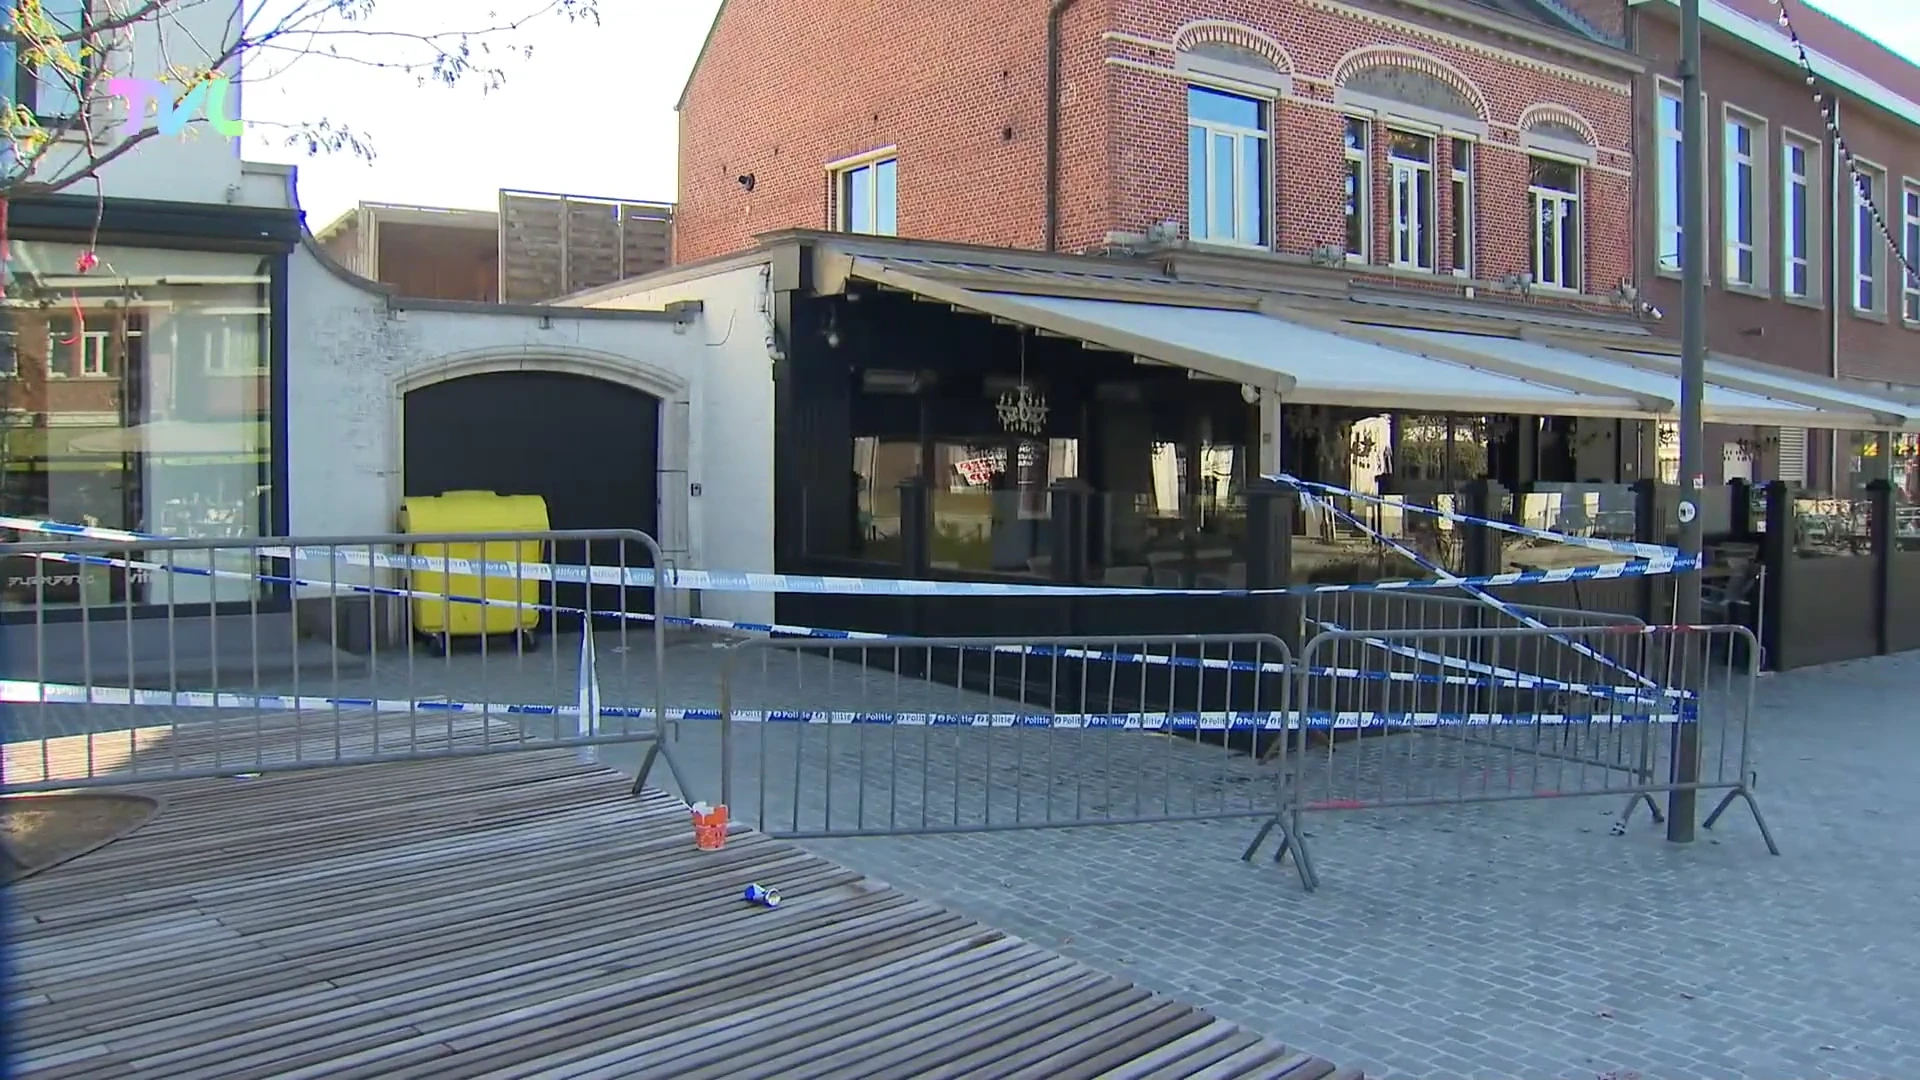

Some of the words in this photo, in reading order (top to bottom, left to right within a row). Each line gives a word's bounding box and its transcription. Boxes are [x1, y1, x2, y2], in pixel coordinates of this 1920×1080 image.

[866, 712, 892, 721] Politie
[1025, 715, 1051, 725] Politie
[1173, 716, 1198, 726] Politie
[1312, 717, 1331, 727] Politi
